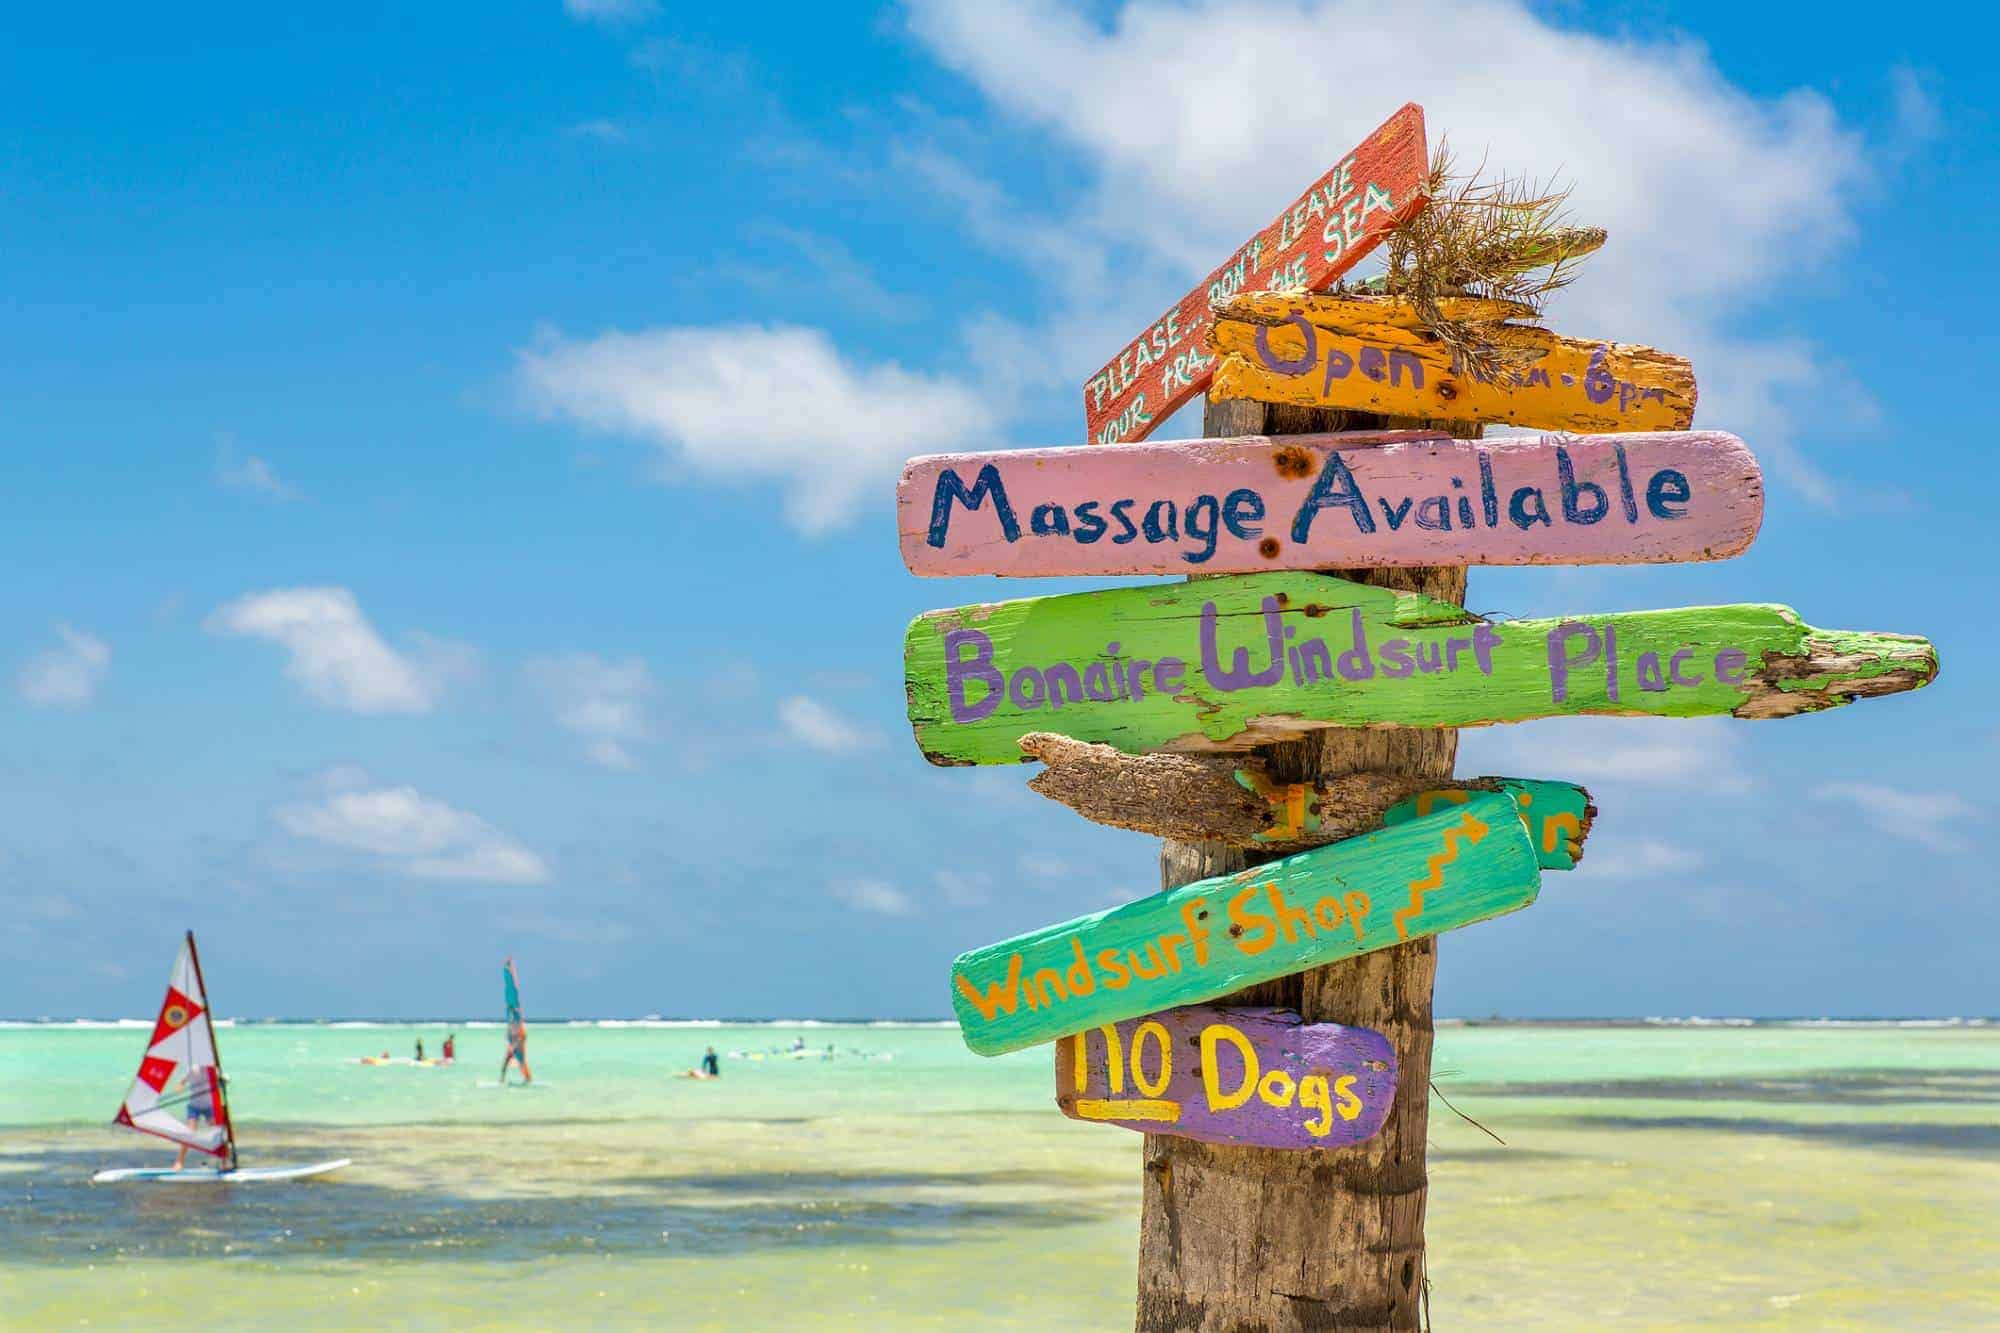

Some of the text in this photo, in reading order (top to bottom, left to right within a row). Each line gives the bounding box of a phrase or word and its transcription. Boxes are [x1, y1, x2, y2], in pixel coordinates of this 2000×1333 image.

[1277, 156, 1357, 252] LEAVE
[1096, 392, 1152, 443] YOUR
[1323, 183, 1395, 263] SEA
[1255, 310, 1424, 397] Open
[927, 444, 1691, 563] Massage Available
[944, 596, 1747, 724] Bonaire Windsurf Place
[955, 883, 1370, 1021] Windsurf Shop
[1200, 1024, 1362, 1137] Dogs
